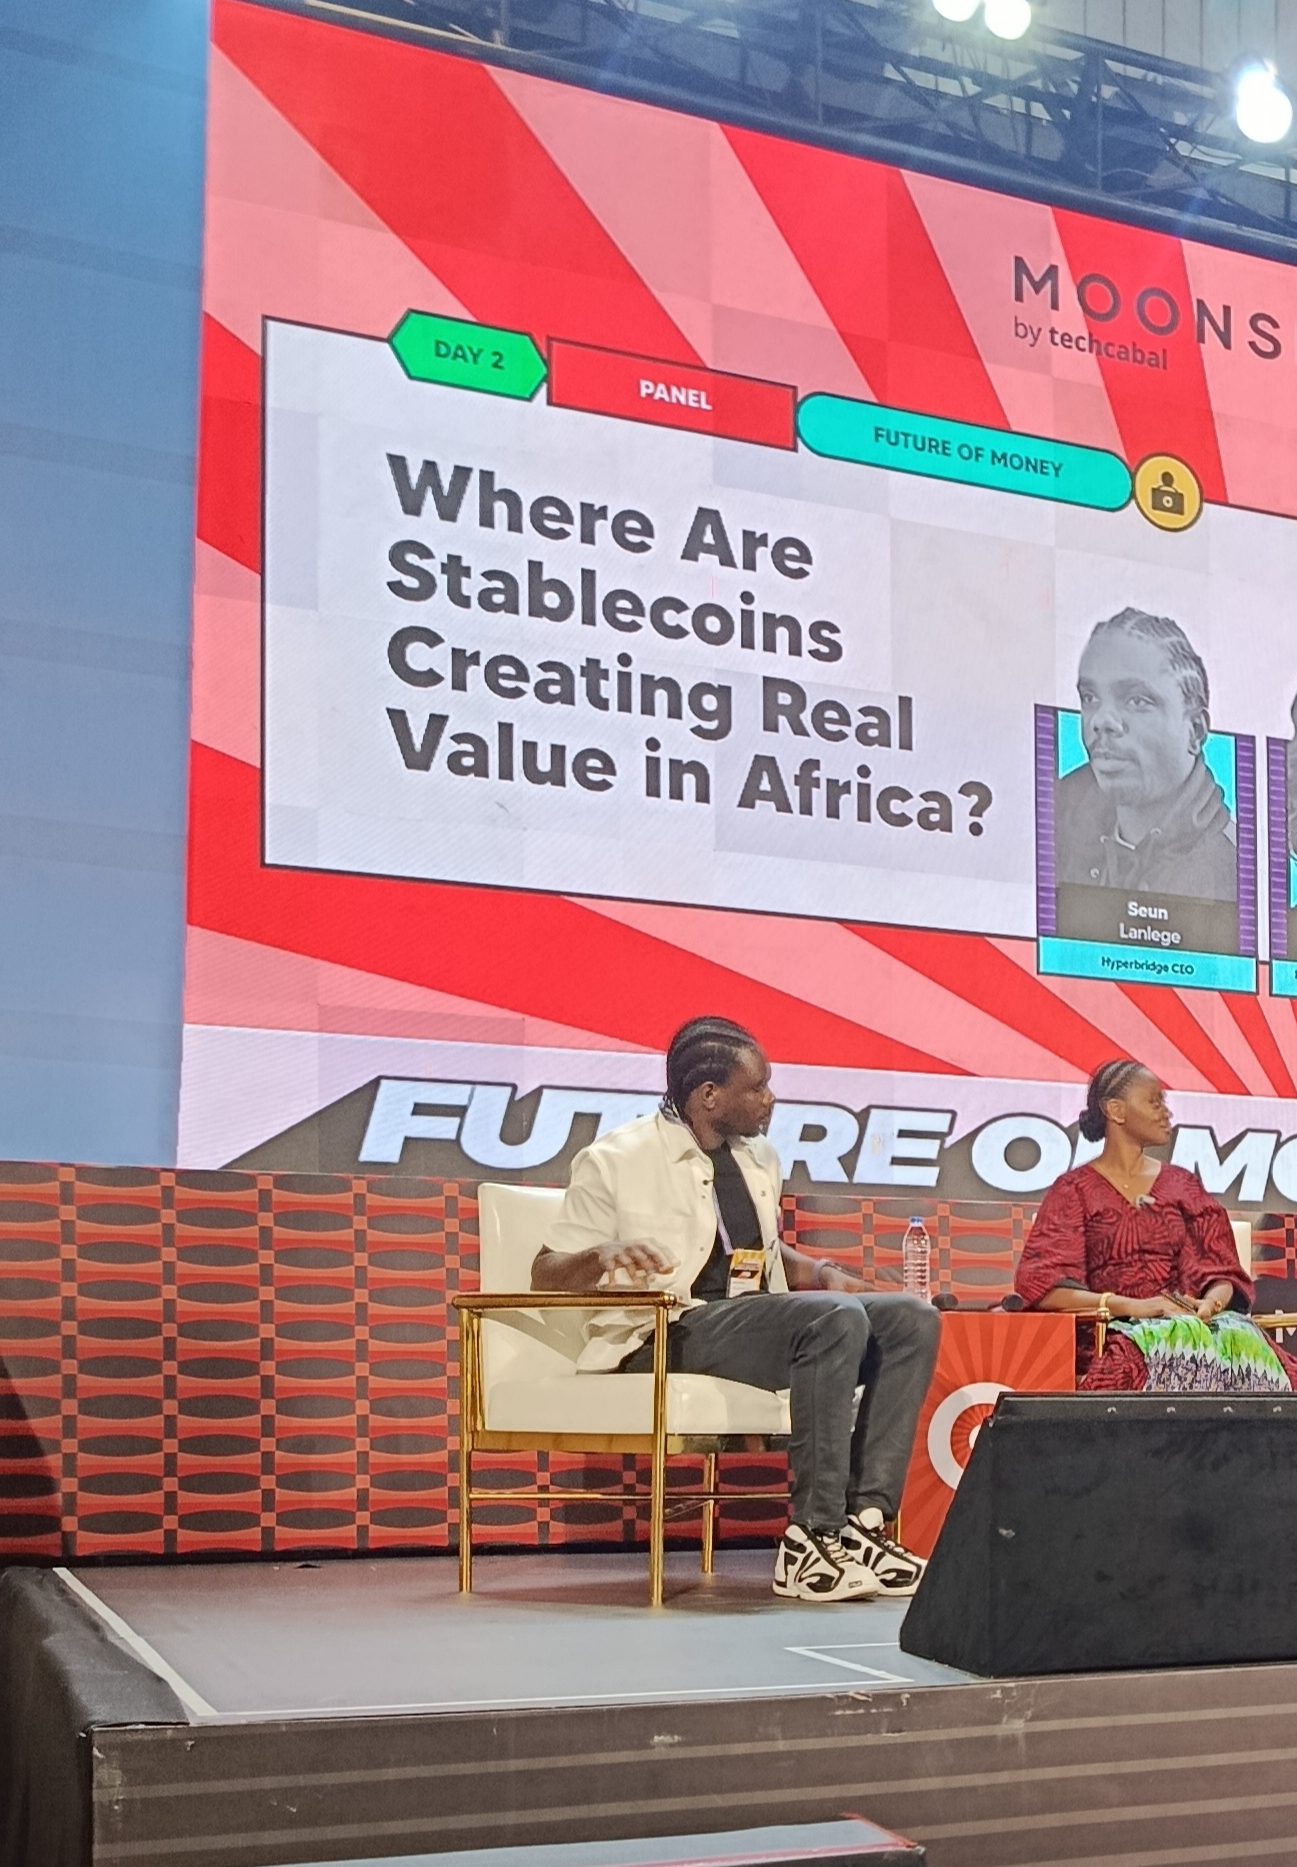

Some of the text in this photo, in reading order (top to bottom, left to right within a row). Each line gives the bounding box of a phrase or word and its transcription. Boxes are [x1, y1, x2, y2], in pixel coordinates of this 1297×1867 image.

[433, 338, 505, 370] DAY 2
[1014, 319, 1168, 370] by techcabal
[638, 378, 712, 410] PANEL
[873, 426, 1064, 479] FUTURE OF MONEY
[387, 453, 813, 580] Where Are
[387, 542, 844, 663] Stablecoins
[387, 628, 913, 752] Creating Real
[387, 707, 993, 837] Value in Africa?
[1101, 956, 1169, 975] Hyperbridge
[358, 1078, 956, 1186] FUTRE
